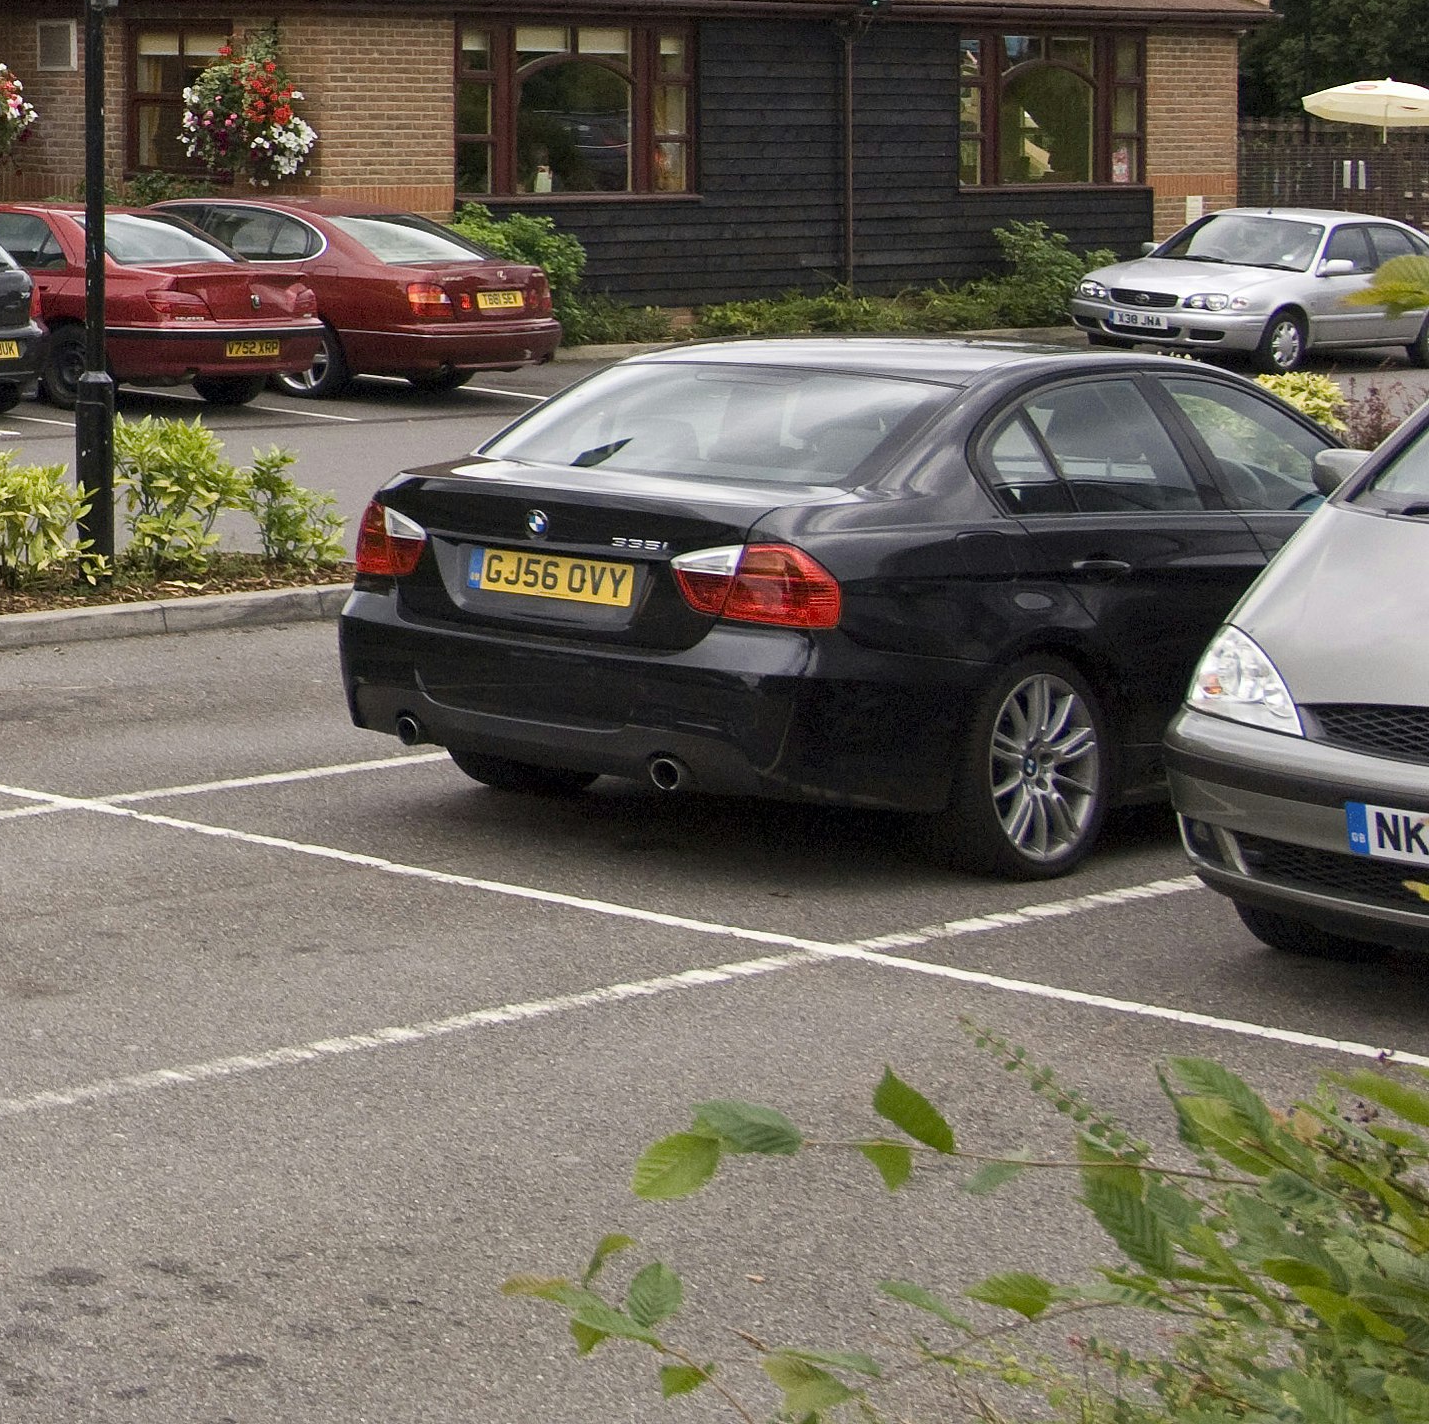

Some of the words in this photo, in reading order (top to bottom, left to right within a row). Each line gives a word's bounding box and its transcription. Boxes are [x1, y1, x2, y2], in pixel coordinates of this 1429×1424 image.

[228, 342, 256, 355] V752
[259, 341, 279, 353] XRP
[486, 554, 560, 590] GJ56
[567, 563, 627, 598] OVY
[1375, 811, 1429, 856] NK
